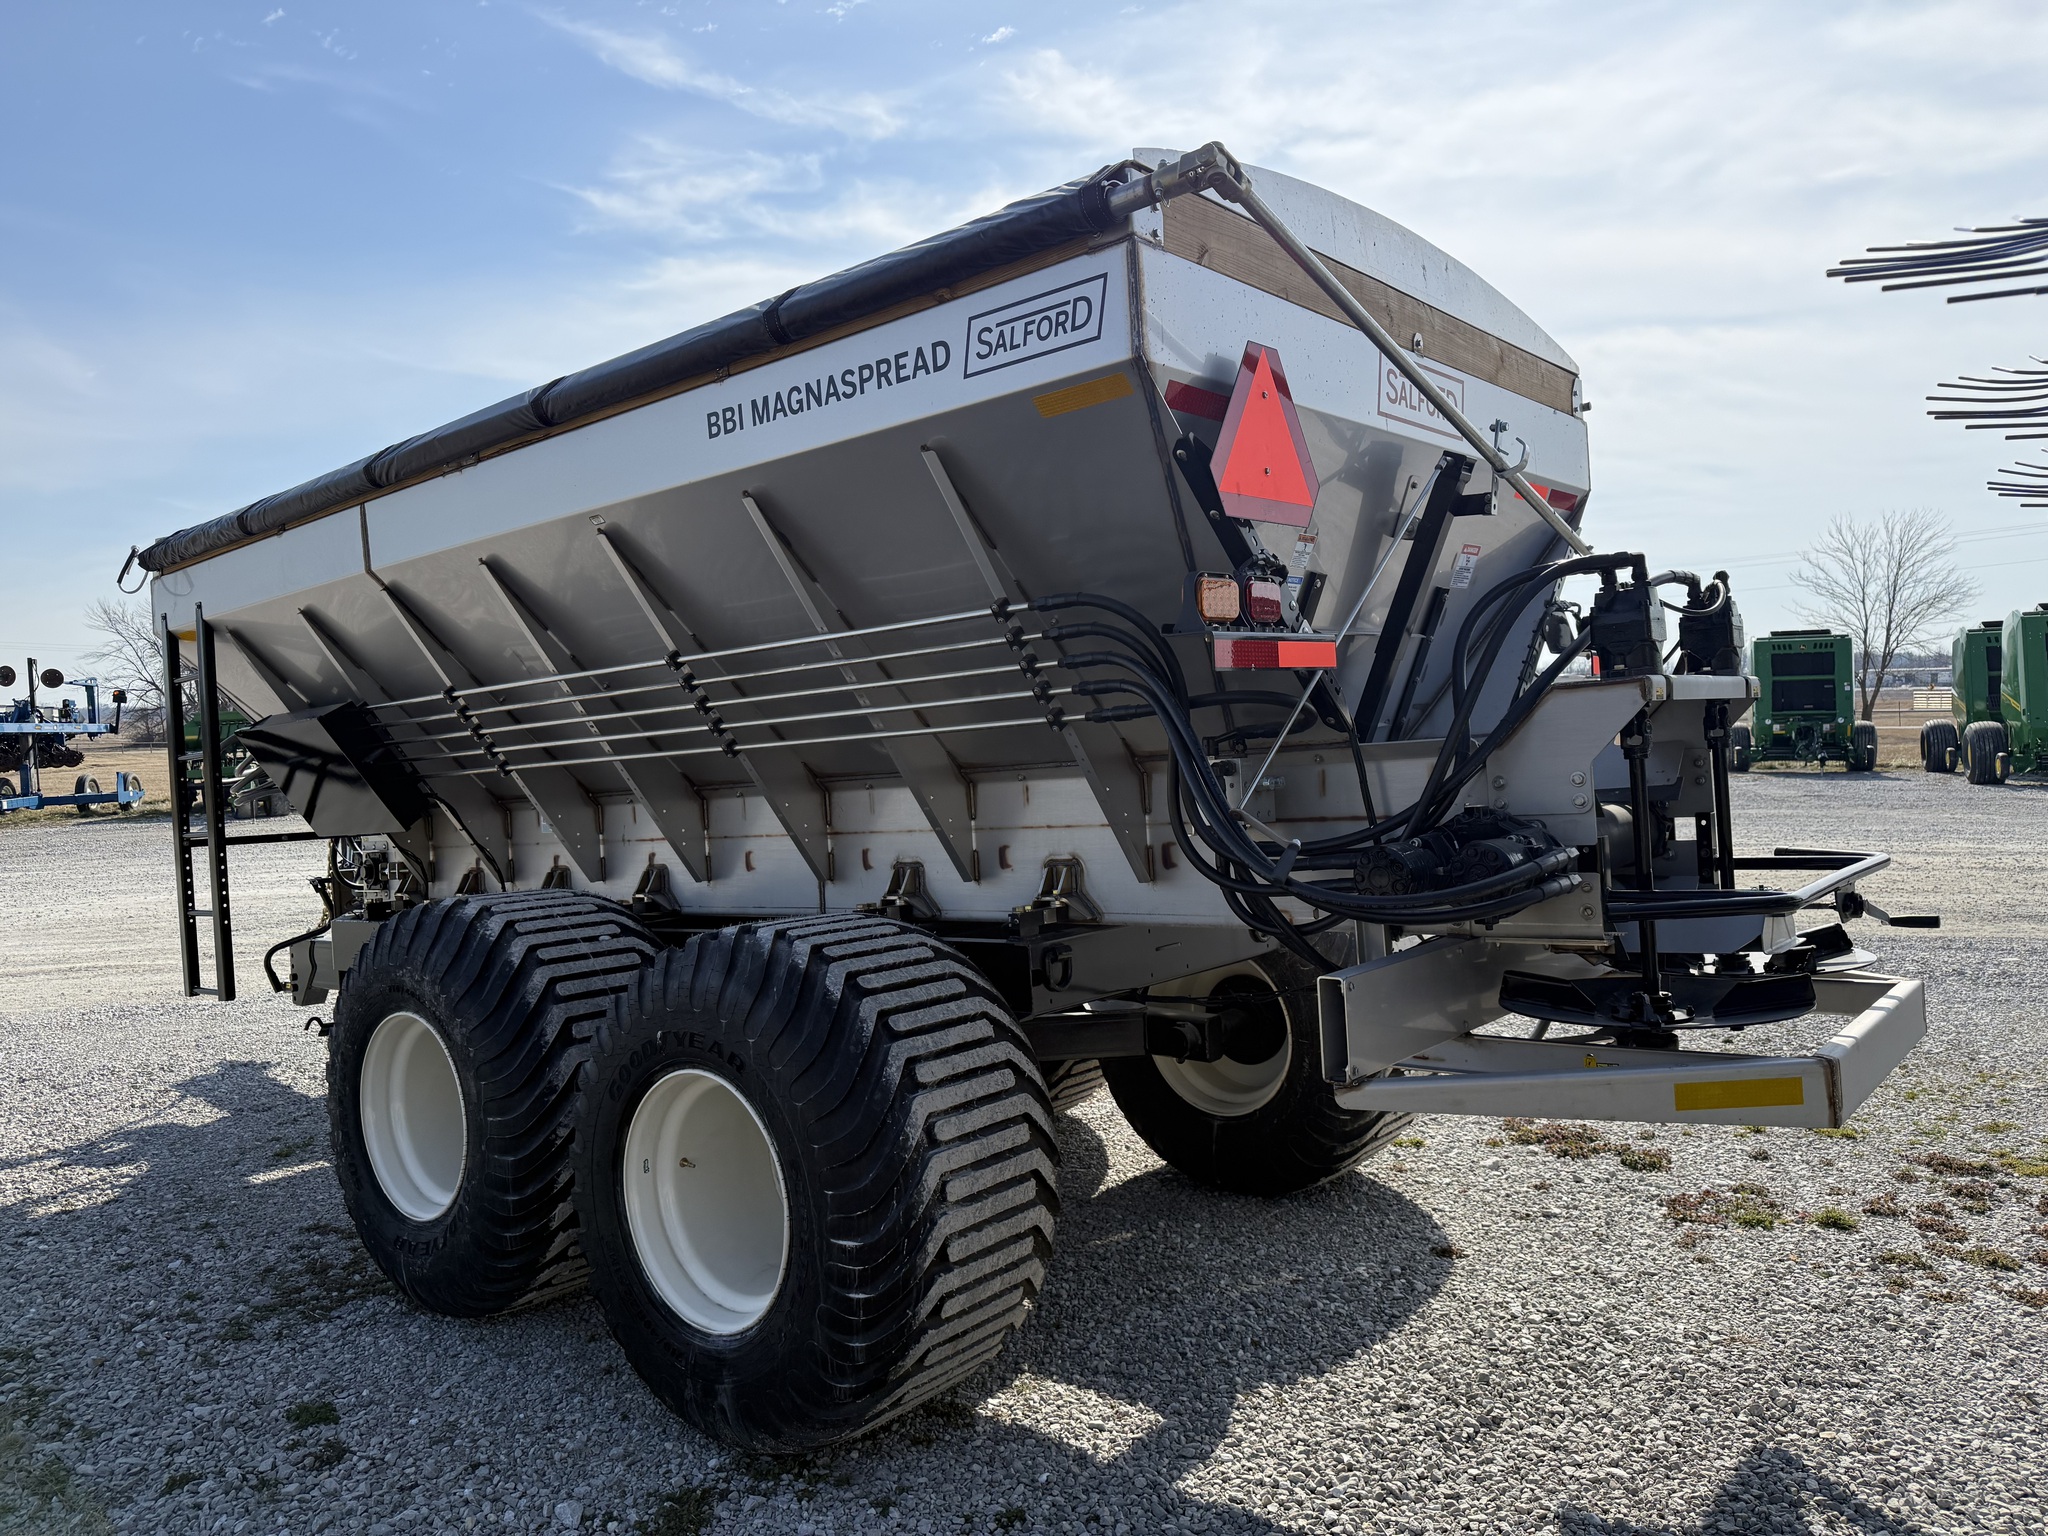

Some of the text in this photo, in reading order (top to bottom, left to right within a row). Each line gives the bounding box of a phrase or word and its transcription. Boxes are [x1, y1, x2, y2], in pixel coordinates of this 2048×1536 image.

[975, 295, 1093, 360] SALFORD
[707, 340, 951, 439] BBI MAGNASPREAD
[609, 1030, 746, 1102] GOODYEAR
